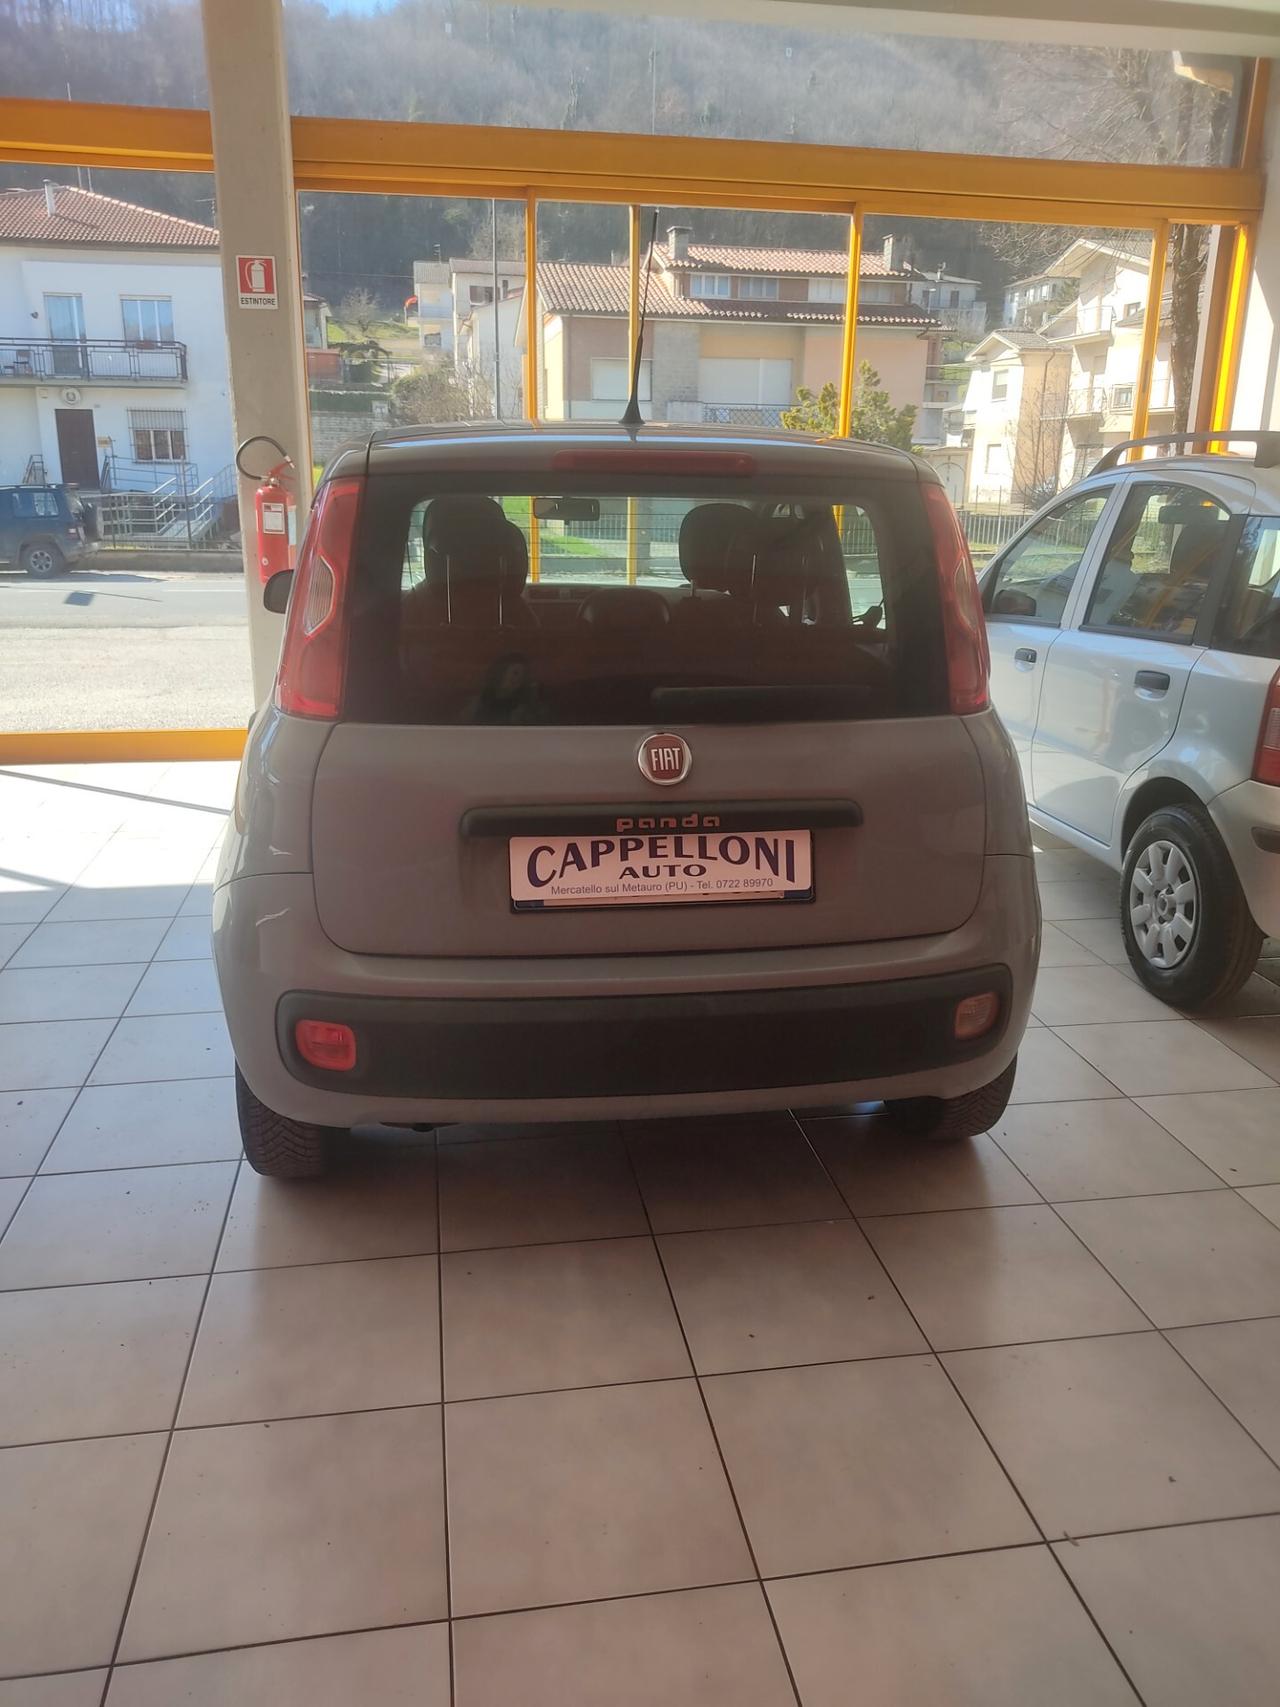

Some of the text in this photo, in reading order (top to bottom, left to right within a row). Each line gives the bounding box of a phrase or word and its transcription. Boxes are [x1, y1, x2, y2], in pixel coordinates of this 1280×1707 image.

[240, 297, 276, 306] ESTINTORE
[650, 747, 681, 771] FIAT
[616, 813, 720, 832] panda
[527, 835, 796, 888] CAPPELLONI
[618, 863, 707, 880] AUTO
[551, 884, 602, 895] Mercatello
[605, 883, 619, 893] sul
[622, 883, 662, 893] Metauro
[665, 881, 688, 892] (PU)
[697, 880, 713, 890] Tel.
[716, 879, 741, 889] 0722
[743, 878, 774, 888] 89970
